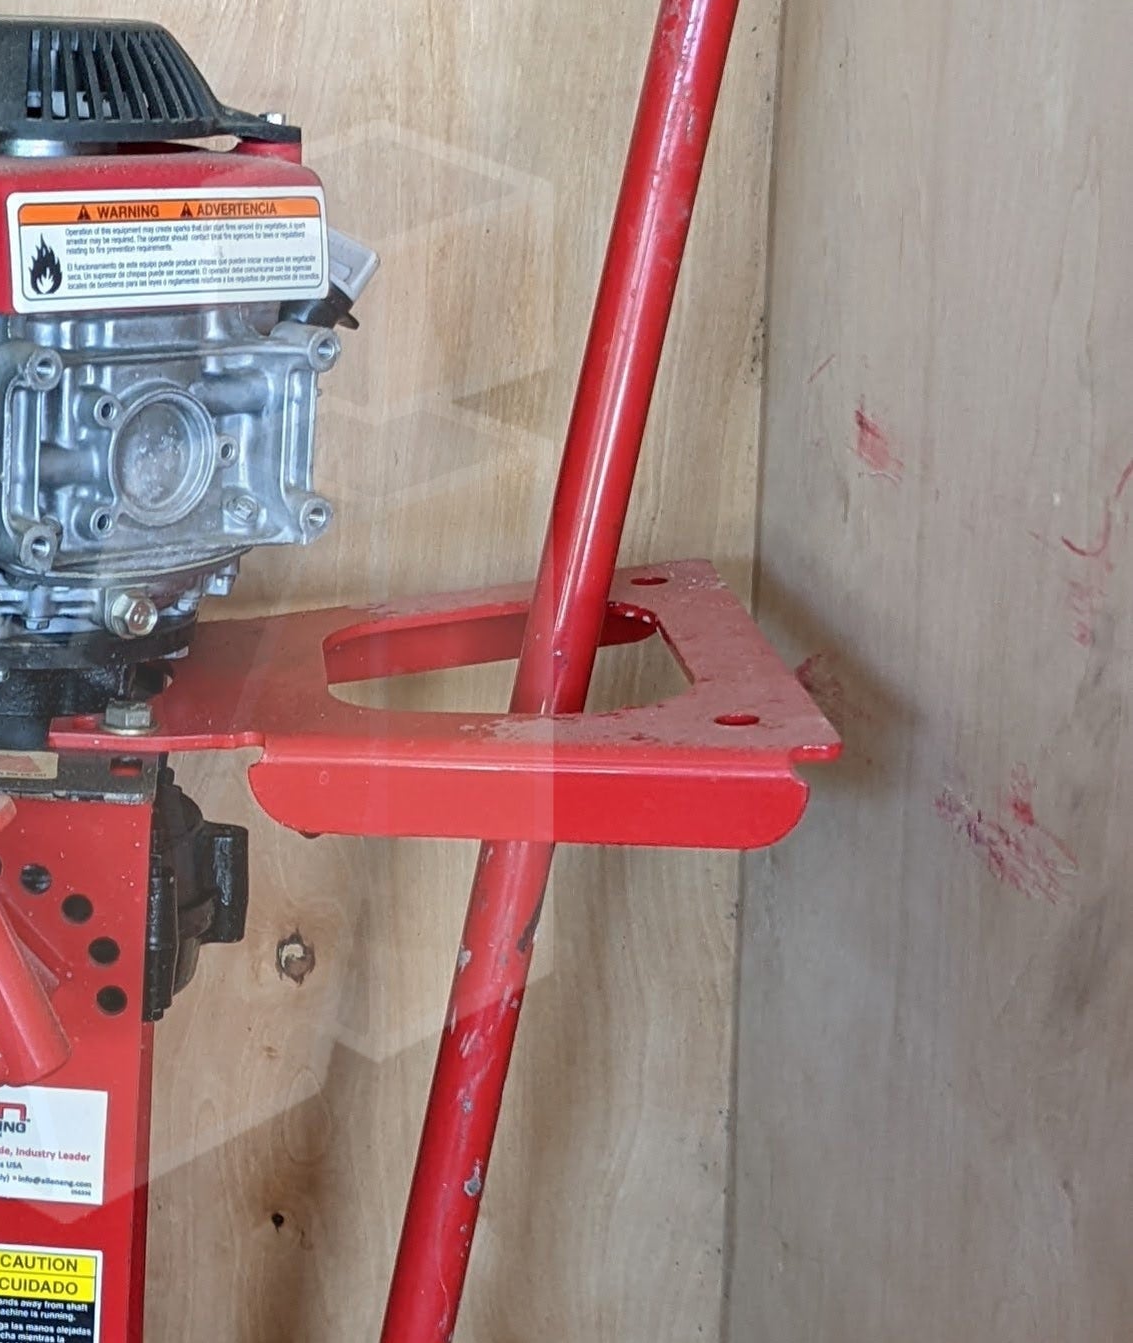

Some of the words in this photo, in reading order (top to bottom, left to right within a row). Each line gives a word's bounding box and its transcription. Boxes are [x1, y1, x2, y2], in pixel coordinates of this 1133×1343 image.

[97, 204, 159, 219] WARNING
[196, 201, 277, 216] ADVERTENCIA
[15, 1147, 55, 1160] Industry
[58, 1150, 90, 1161] Leader
[6, 1160, 22, 1168] USA
[0, 1253, 77, 1272] CAUTION
[20, 1299, 41, 1309] away
[44, 1301, 64, 1309] from
[65, 1302, 87, 1311] shaft
[40, 1311, 75, 1322] running.
[11, 1322, 23, 1330] las
[25, 1323, 54, 1332] manos
[56, 1325, 91, 1336] alejadas
[17, 1332, 54, 1342] mientras
[56, 1335, 64, 1343] la
